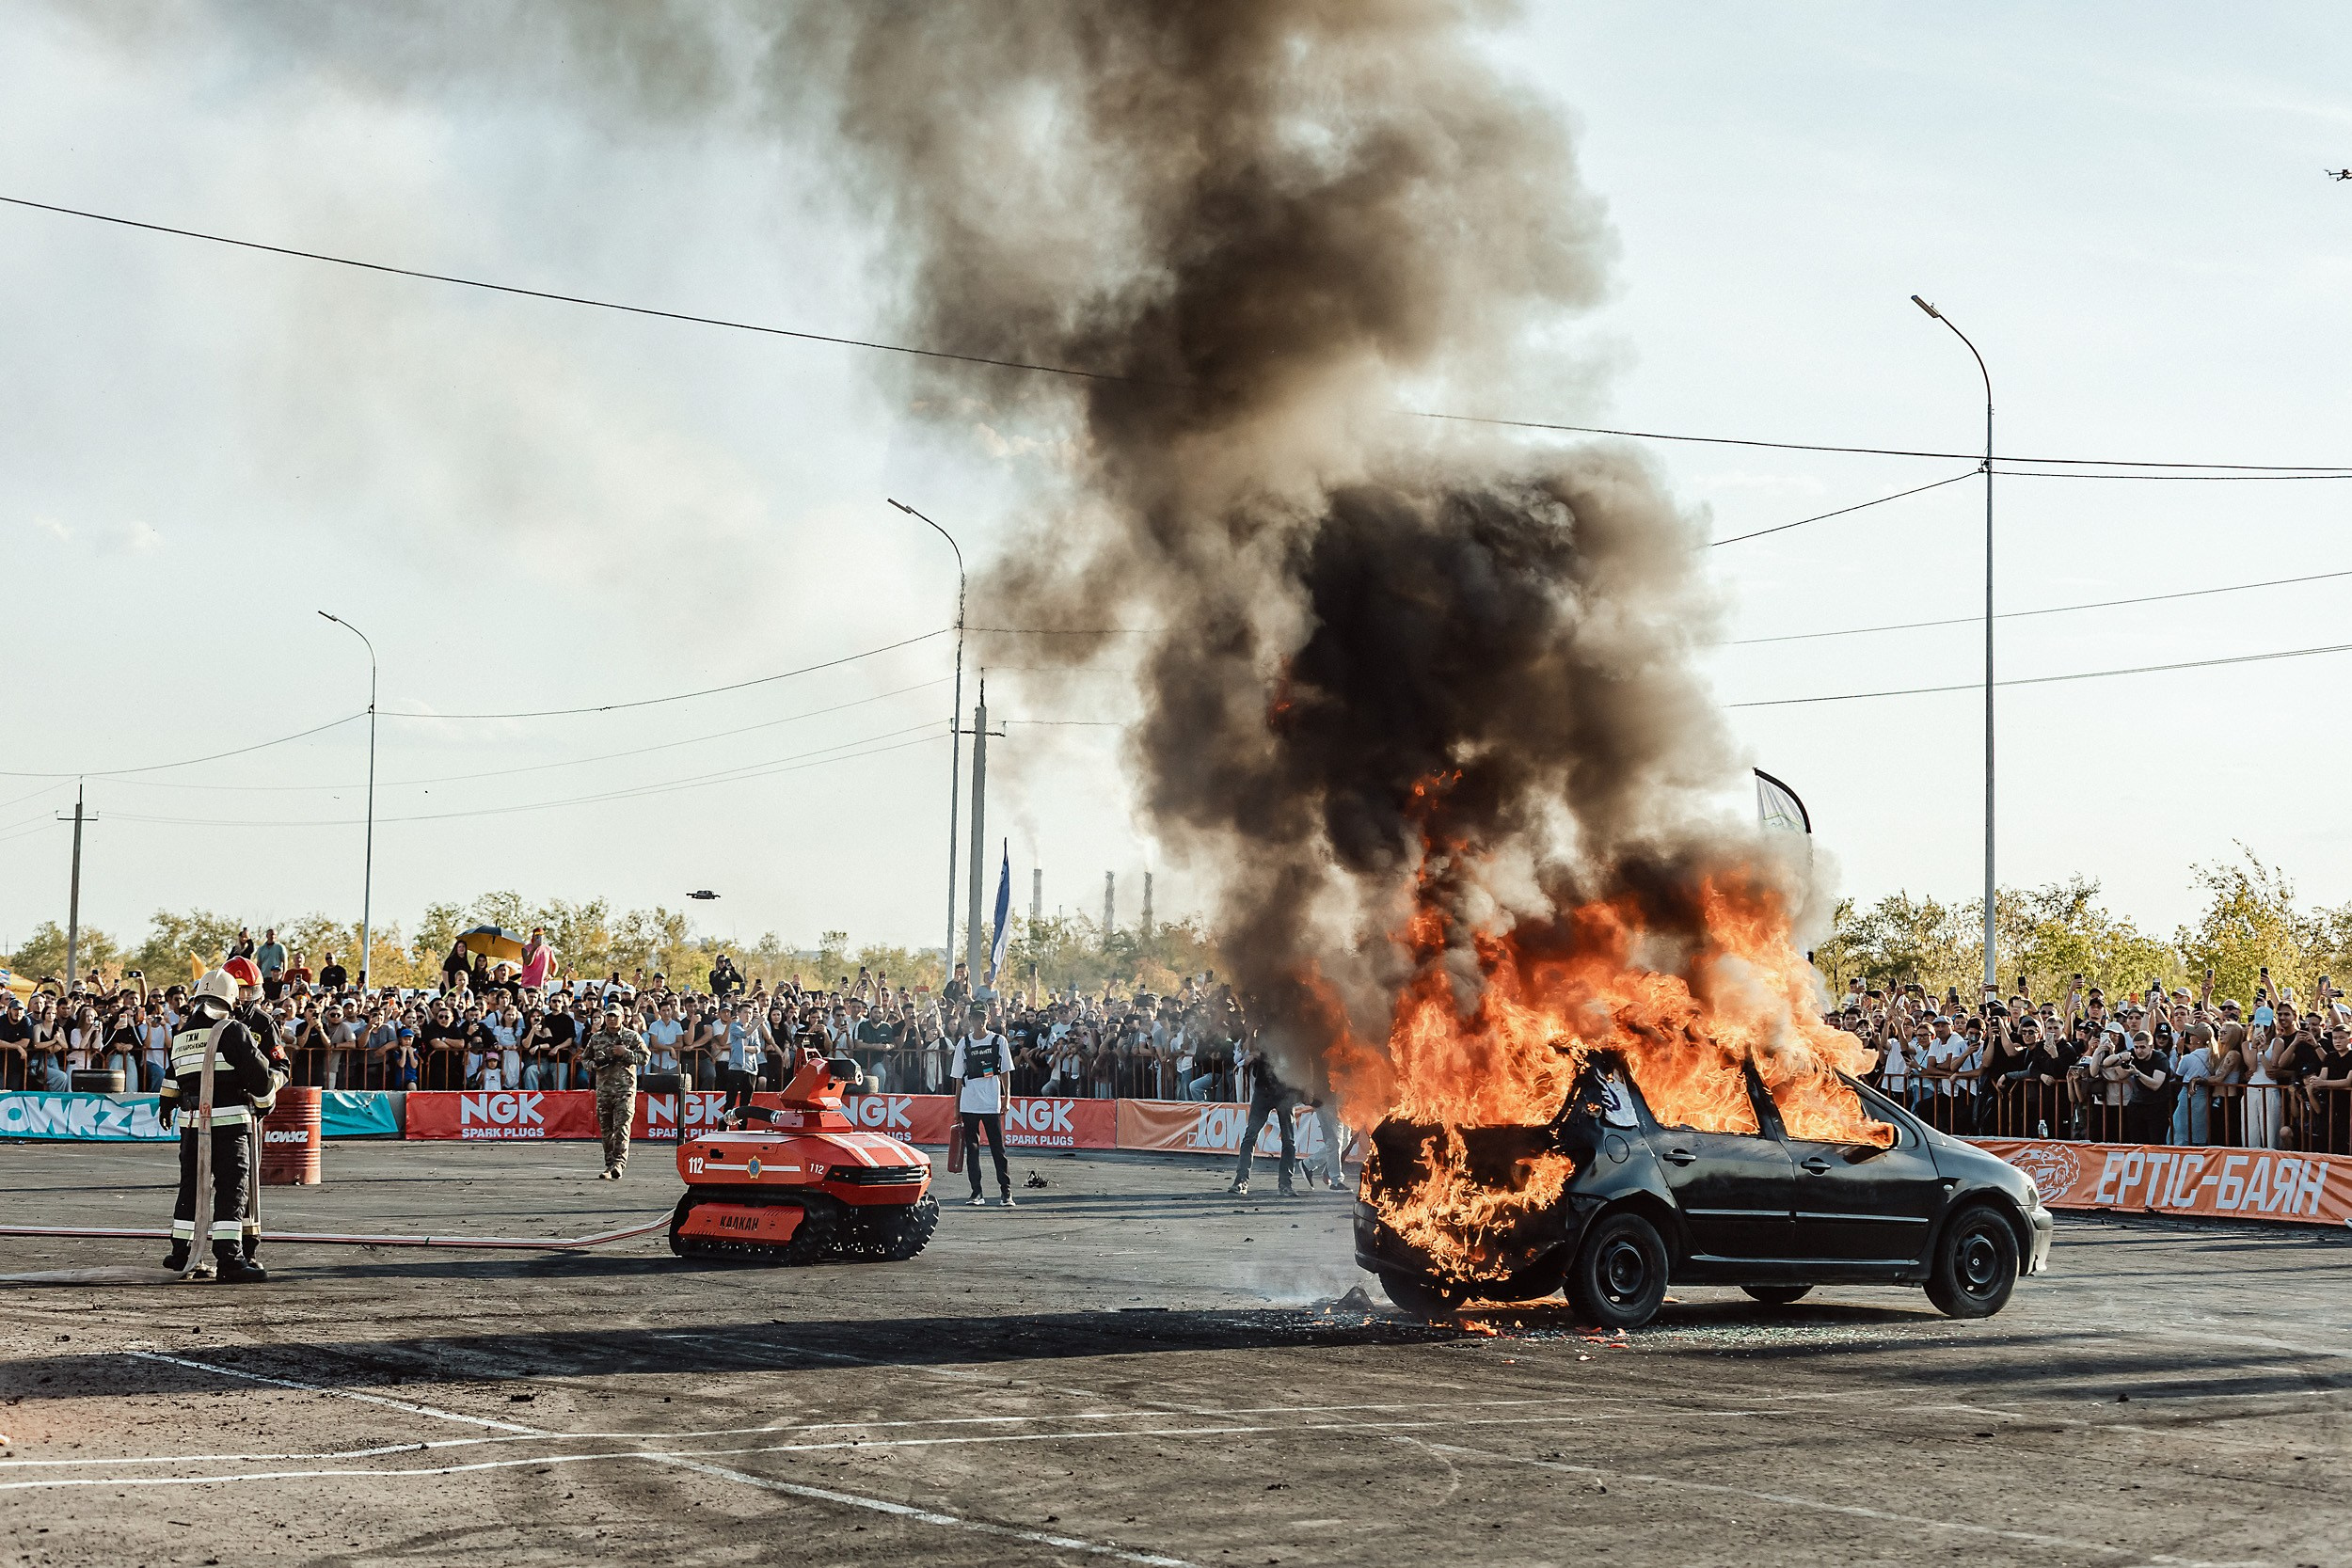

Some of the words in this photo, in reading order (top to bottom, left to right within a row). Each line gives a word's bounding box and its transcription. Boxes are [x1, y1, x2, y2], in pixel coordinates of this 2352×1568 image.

[461, 1092, 545, 1125] NGK
[647, 1094, 727, 1125] NGK
[834, 1096, 913, 1129] NGK
[1005, 1100, 1075, 1133] NGK
[462, 1128, 502, 1139] SPARK
[503, 1128, 545, 1137] PLUGS
[648, 1128, 689, 1138] SPAR
[1005, 1134, 1039, 1145] SPARK
[1040, 1135, 1074, 1146] PLUGS
[688, 1157, 704, 1174] 112
[810, 1163, 824, 1175] 112
[2095, 1152, 2329, 1215] ЕРТІС-БАЯН
[720, 1215, 759, 1230] КАЛКАН
